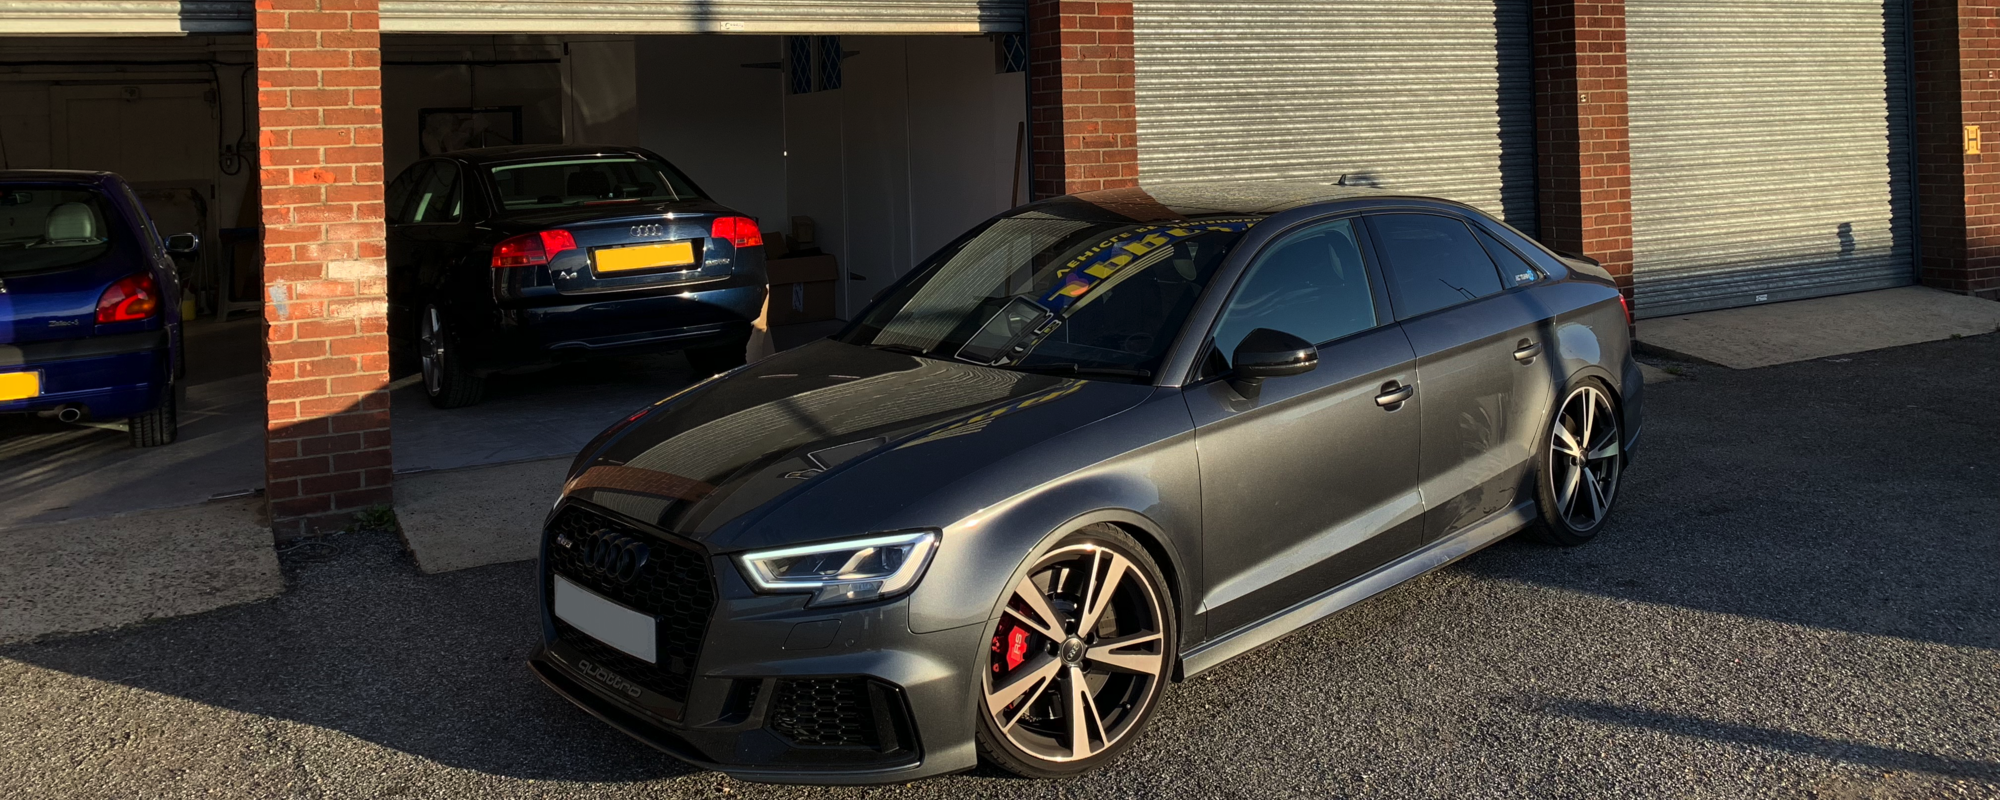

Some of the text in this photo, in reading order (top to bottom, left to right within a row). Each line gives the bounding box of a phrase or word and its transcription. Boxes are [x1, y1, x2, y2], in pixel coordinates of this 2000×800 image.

[1965, 127, 1980, 151] H
[1013, 632, 1023, 655] RS
[578, 659, 642, 698] quattro
